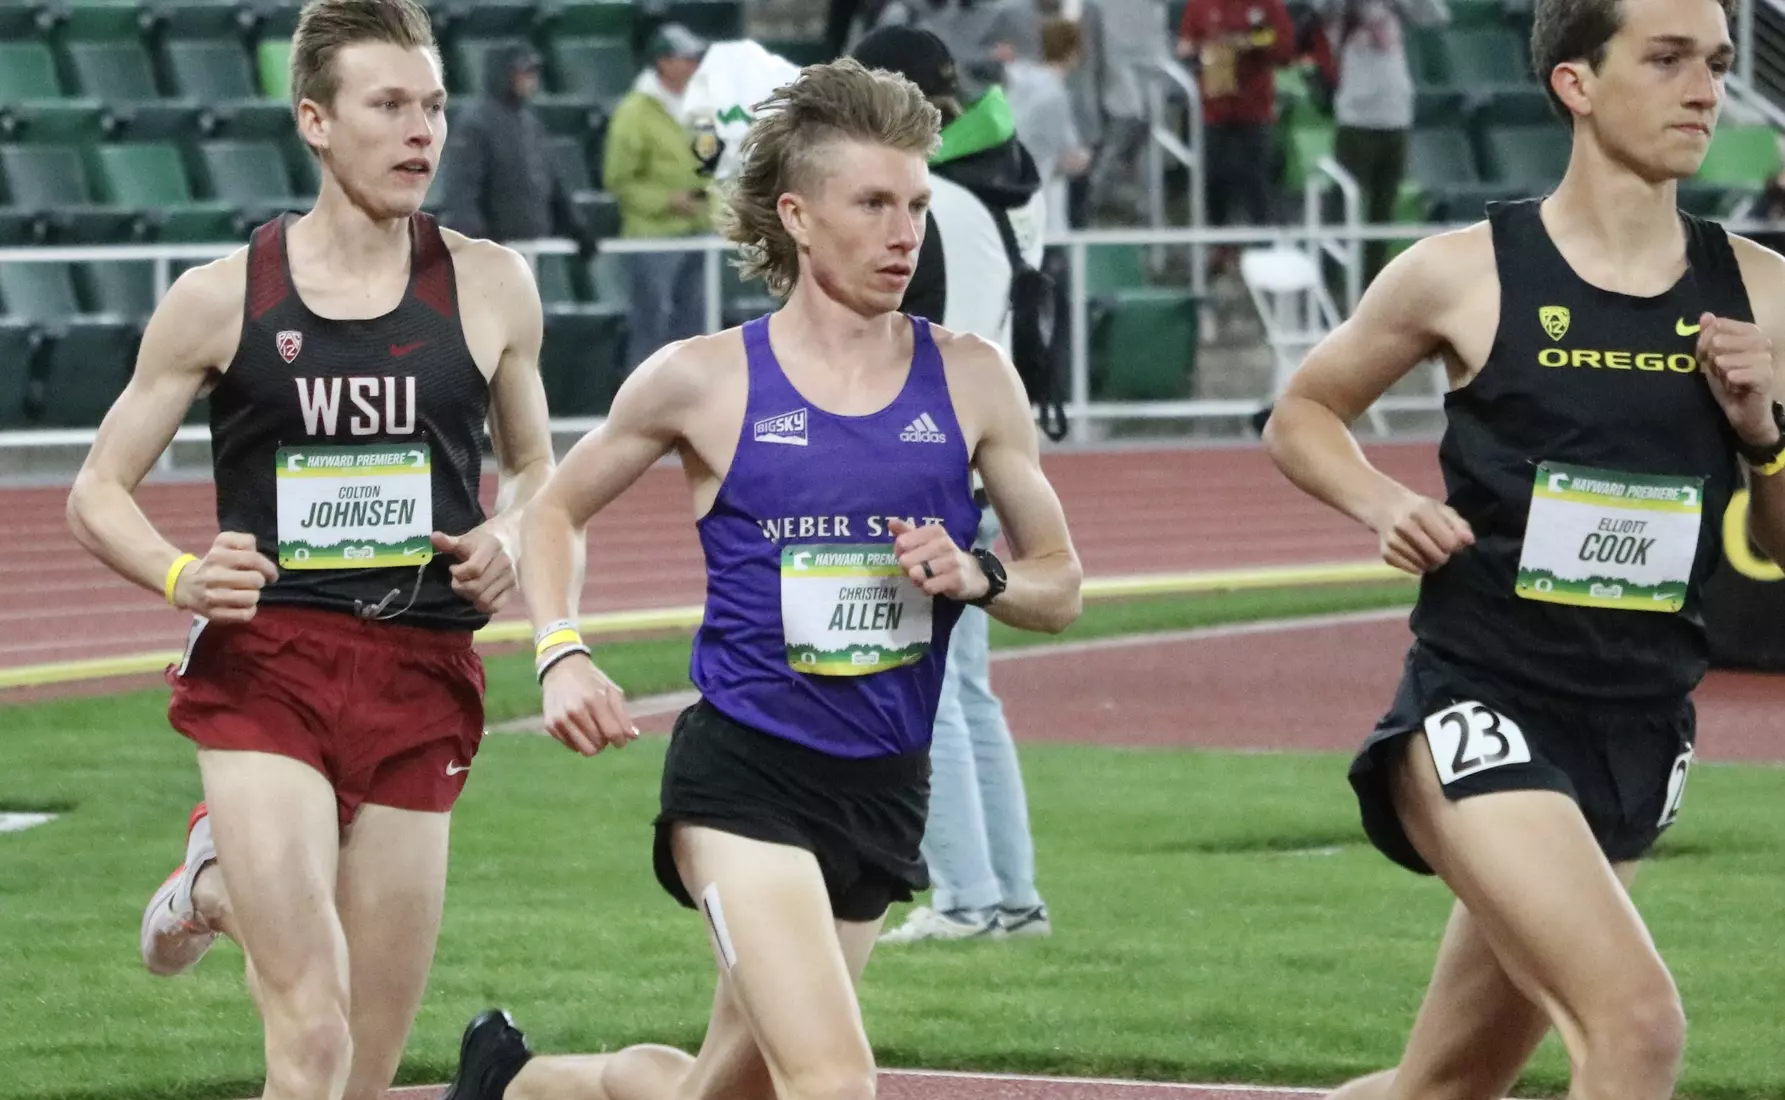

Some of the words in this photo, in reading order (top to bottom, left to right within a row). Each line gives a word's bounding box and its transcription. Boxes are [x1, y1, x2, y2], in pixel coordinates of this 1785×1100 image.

[278, 332, 301, 350] PAC
[283, 344, 296, 356] 12
[1537, 348, 1697, 373] OREGO
[295, 376, 416, 436] WSU
[900, 430, 946, 443] adidas
[307, 456, 354, 468] HAYWARD
[356, 452, 407, 466] PREMIERE
[338, 485, 380, 500] COLTON
[1571, 477, 1624, 495] HAYWARD
[1627, 484, 1681, 501] PREMIERE
[300, 498, 416, 528] JOHNSEN
[757, 516, 851, 542] WEBER
[1598, 518, 1648, 534] ELLIOTT
[815, 553, 864, 566] HAYWARD
[867, 553, 900, 566] PREM
[1578, 533, 1657, 566] COOK
[839, 587, 898, 601] CHRISTIAN
[828, 602, 903, 631] ALLEN
[1440, 705, 1510, 774] 23
[1666, 758, 1687, 822] 2
